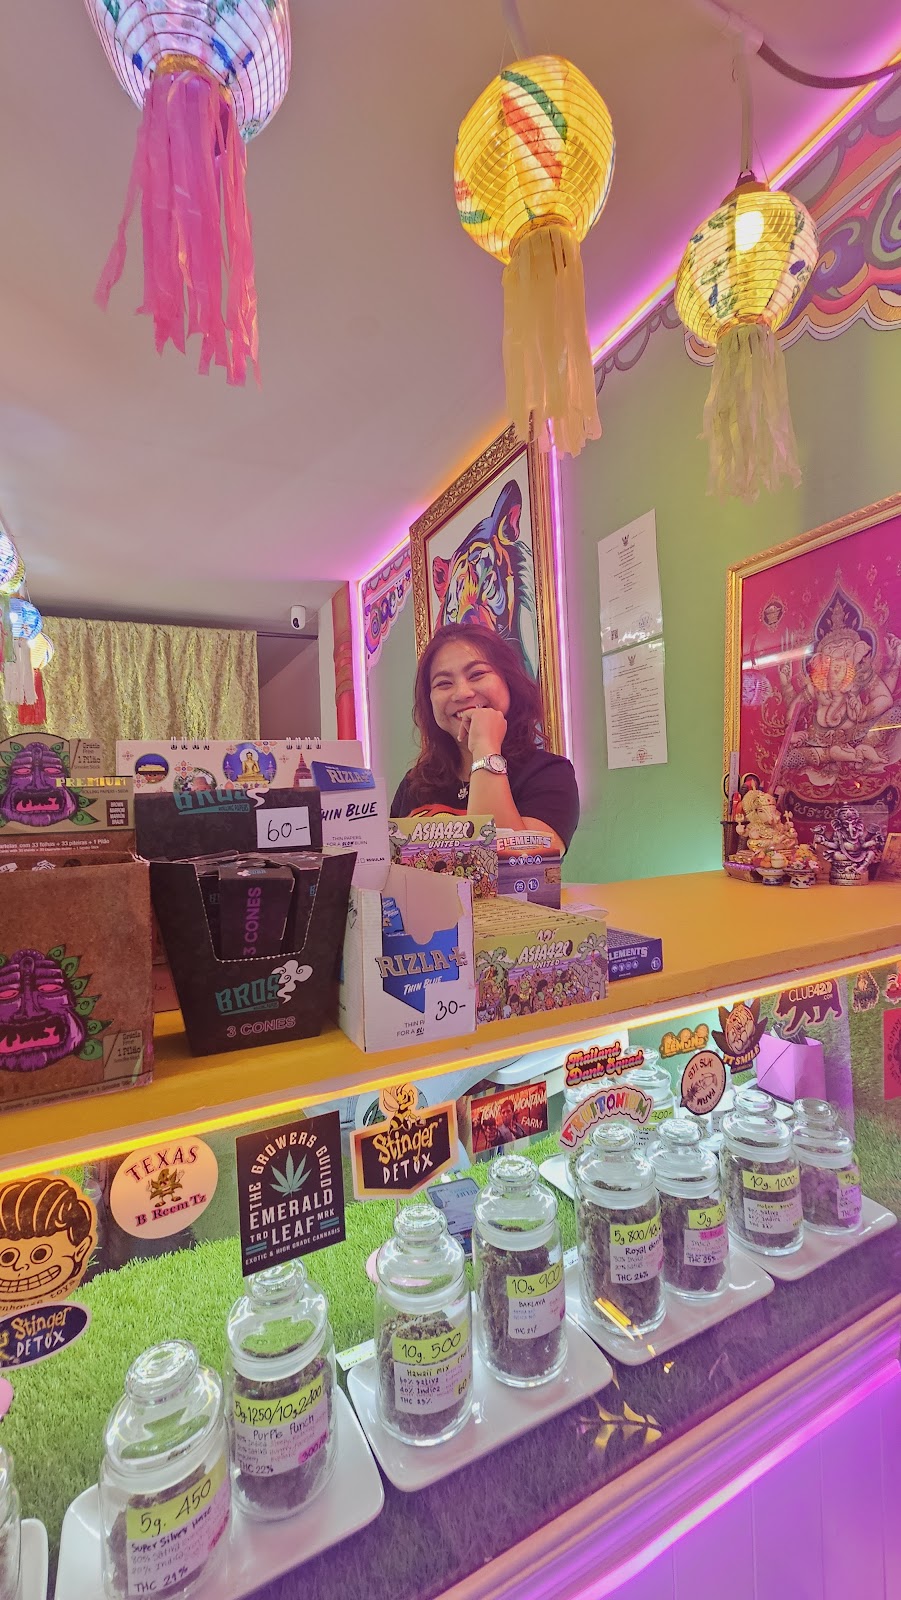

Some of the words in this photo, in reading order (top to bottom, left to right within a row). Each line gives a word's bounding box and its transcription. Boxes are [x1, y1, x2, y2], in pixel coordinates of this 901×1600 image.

[55, 777, 127, 788] PREMIUM
[346, 801, 378, 818] BLUE
[267, 819, 308, 842] 60-
[496, 835, 551, 850] ELEMENTS
[428, 840, 461, 849] UNITED
[245, 886, 261, 943] CONES
[243, 946, 257, 956] 3
[532, 959, 560, 970] UNITED
[608, 947, 649, 960] LEMENTS
[215, 974, 281, 1013] BROS
[403, 981, 422, 995] THIN
[404, 1020, 419, 1028] THIN
[436, 1000, 466, 1021] 30-
[227, 1025, 237, 1038] 3
[240, 1016, 296, 1036] CONES
[566, 1041, 621, 1070] Thailand
[566, 1062, 606, 1086] Dank
[605, 1049, 645, 1076] Squad
[480, 1101, 501, 1125] TONY
[513, 1089, 547, 1112] MONTANA
[697, 1088, 716, 1106] FARM
[521, 1116, 543, 1129] FARM
[251, 1131, 318, 1175] GROWERS
[372, 1121, 438, 1166] Stinger
[125, 1146, 198, 1182] TEXAS
[316, 1145, 332, 1188] GUILD
[383, 1153, 433, 1184] DETOX
[249, 1182, 262, 1211] THE
[250, 1188, 334, 1230] EMERALD
[135, 1213, 147, 1227] B
[250, 1230, 268, 1243] TRD
[271, 1216, 315, 1245] LEAF
[317, 1208, 335, 1221] MRK
[246, 1253, 267, 1265] EXOTIC
[269, 1250, 274, 1258] &
[276, 1245, 291, 1255] HIGH
[292, 1238, 310, 1249] GRADE
[312, 1227, 341, 1243] CANNABIS
[625, 1246, 647, 1256] Royal
[616, 1273, 632, 1281] THC
[11, 1306, 72, 1340] Stinger
[16, 1329, 65, 1357] DETOX
[432, 1332, 461, 1359] 500
[176, 1478, 211, 1520] 450
[134, 1582, 157, 1593] THC
[163, 1566, 188, 1587] 21%
